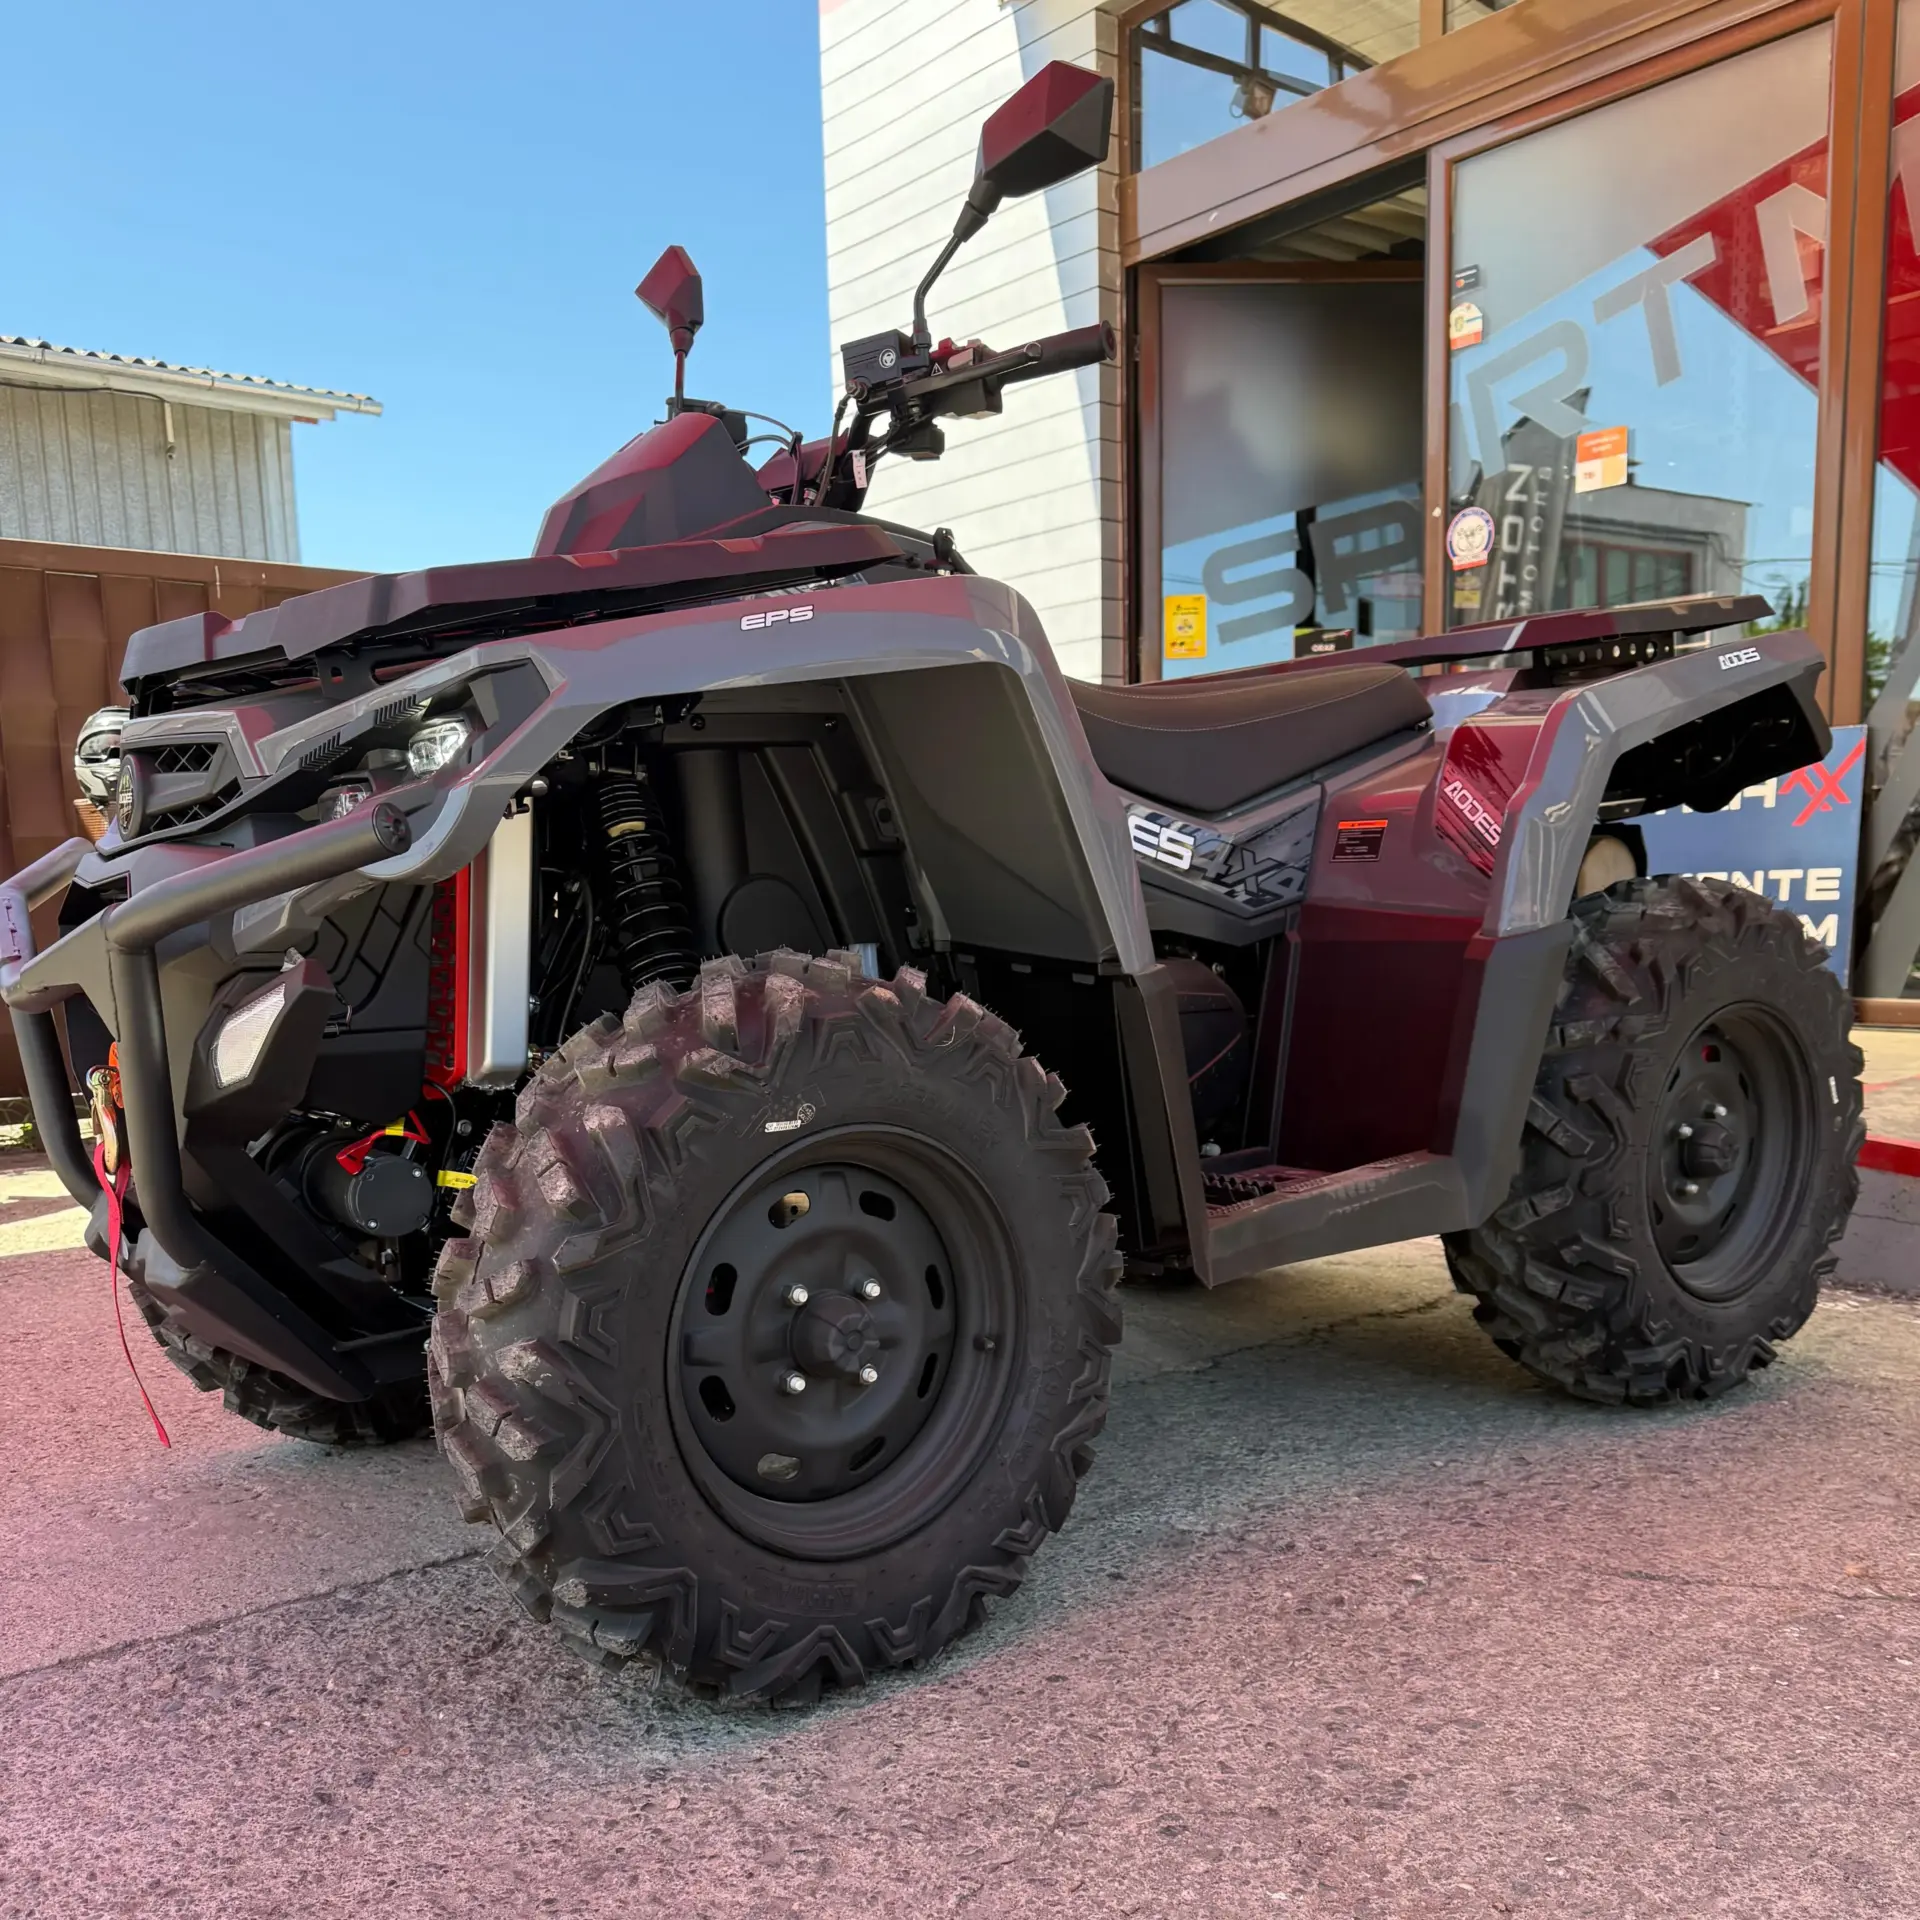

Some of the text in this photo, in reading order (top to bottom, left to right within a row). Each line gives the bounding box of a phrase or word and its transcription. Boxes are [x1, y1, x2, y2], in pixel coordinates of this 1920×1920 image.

[740, 604, 814, 631] EPS
[1718, 647, 1761, 670] AODES
[1444, 780, 1502, 846] AODES
